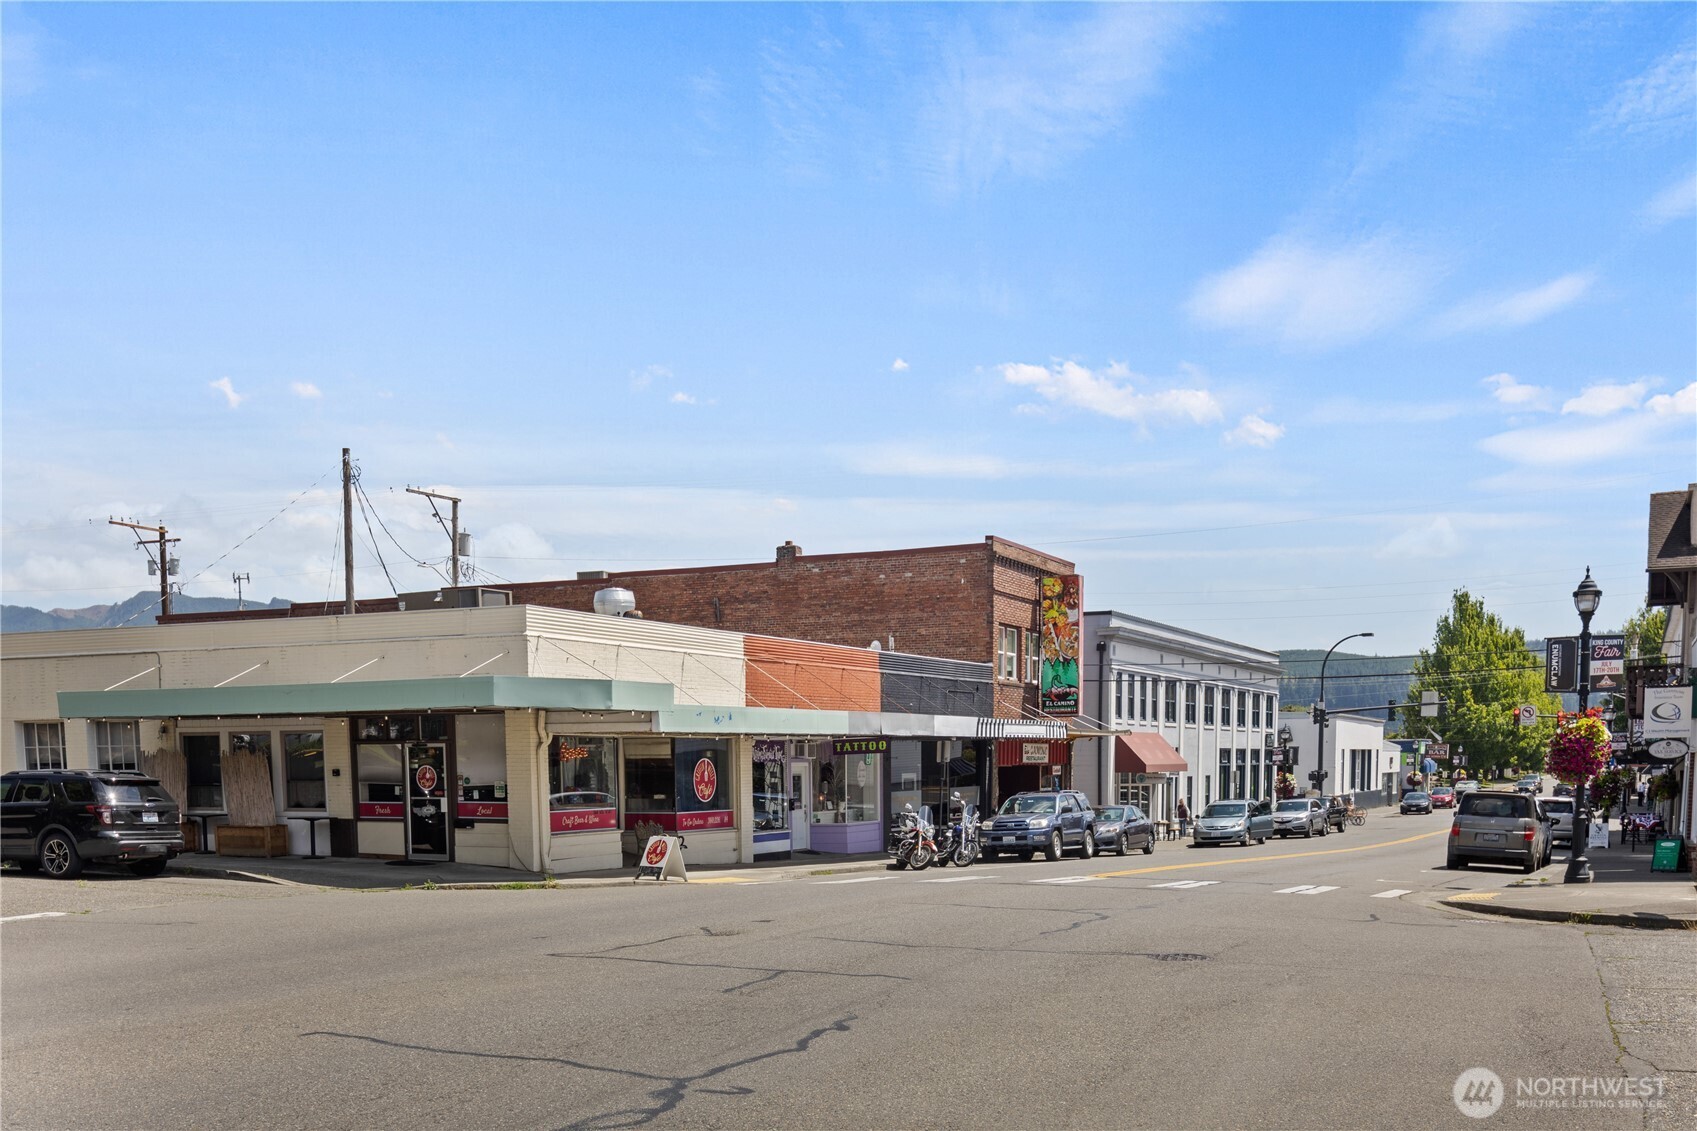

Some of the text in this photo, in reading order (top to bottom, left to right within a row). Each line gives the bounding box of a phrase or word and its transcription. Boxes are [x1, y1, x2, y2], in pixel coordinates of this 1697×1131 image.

[1594, 645, 1621, 658] Fair
[1551, 644, 1559, 687] ENUMCLAW
[835, 740, 887, 752] TATTOO
[697, 782, 713, 799] Café
[374, 805, 392, 815] Fresh
[476, 805, 493, 815] Local
[561, 815, 574, 828] Craft
[574, 815, 584, 824] Beer
